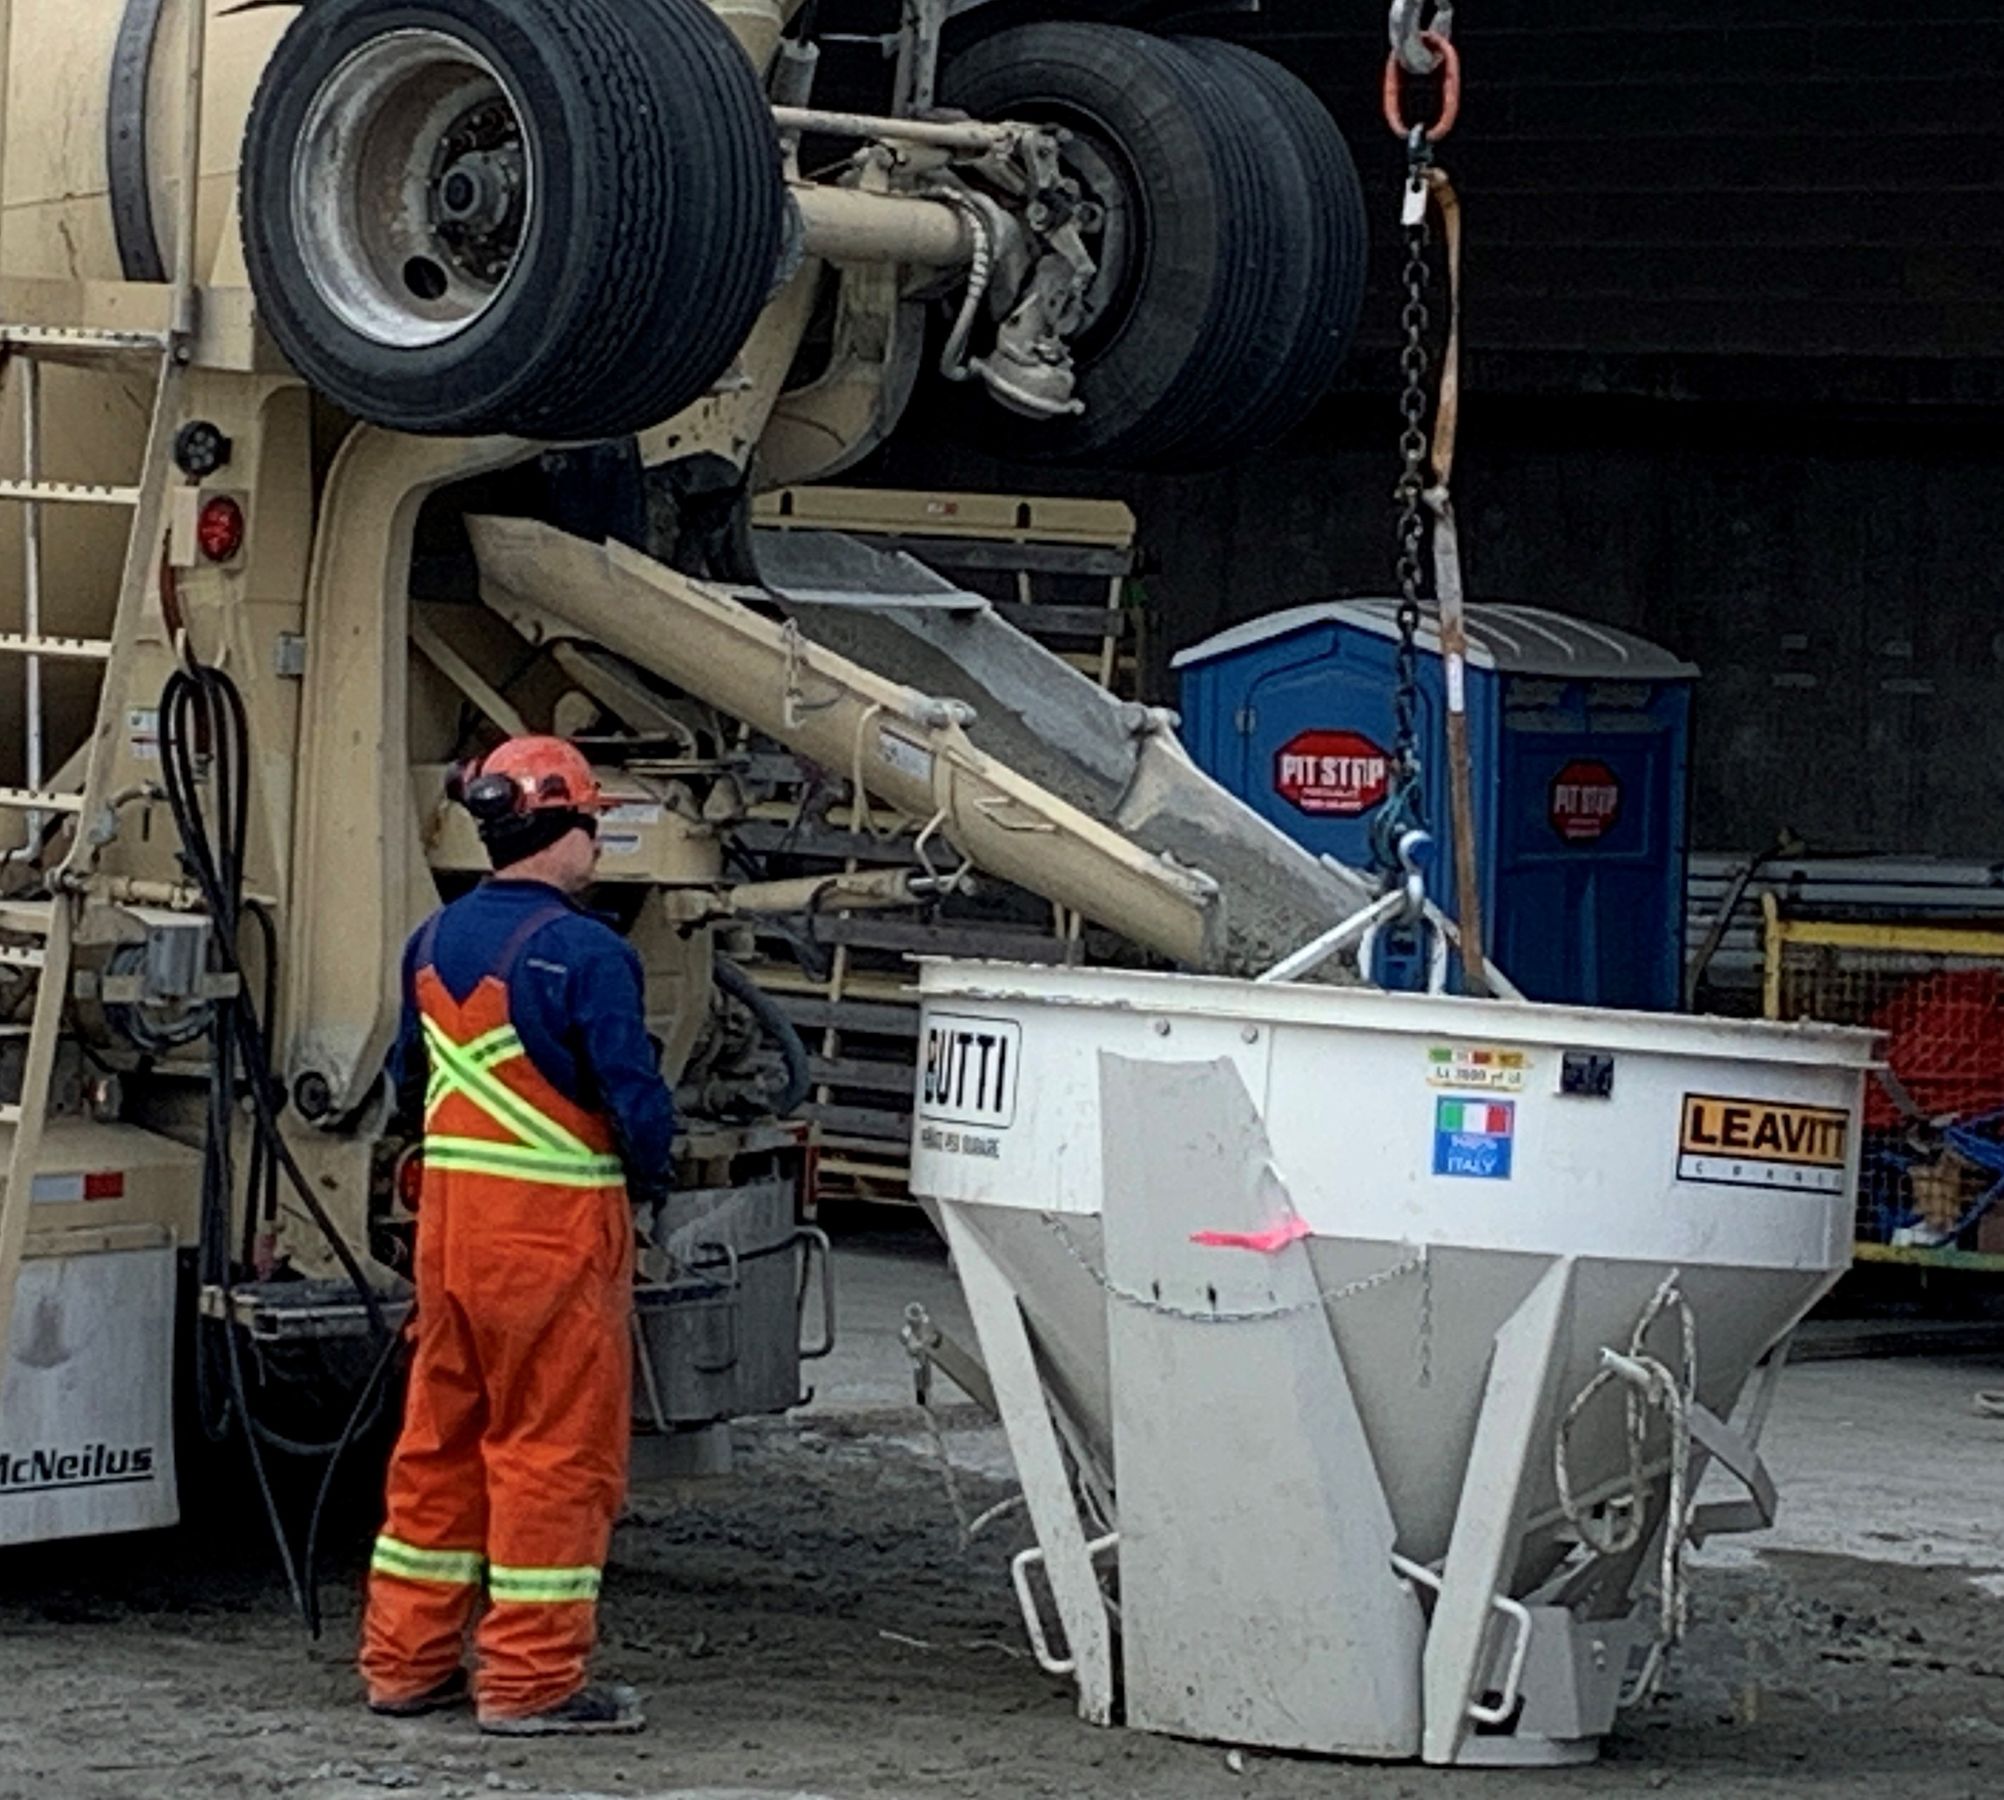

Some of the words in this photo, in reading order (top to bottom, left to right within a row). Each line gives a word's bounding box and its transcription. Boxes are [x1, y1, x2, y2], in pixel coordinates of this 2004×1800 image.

[1281, 754, 1317, 785] PIT
[1320, 755, 1385, 789] STOP
[1554, 784, 1580, 814] PIT
[1690, 1104, 1848, 1158] LEAVITT
